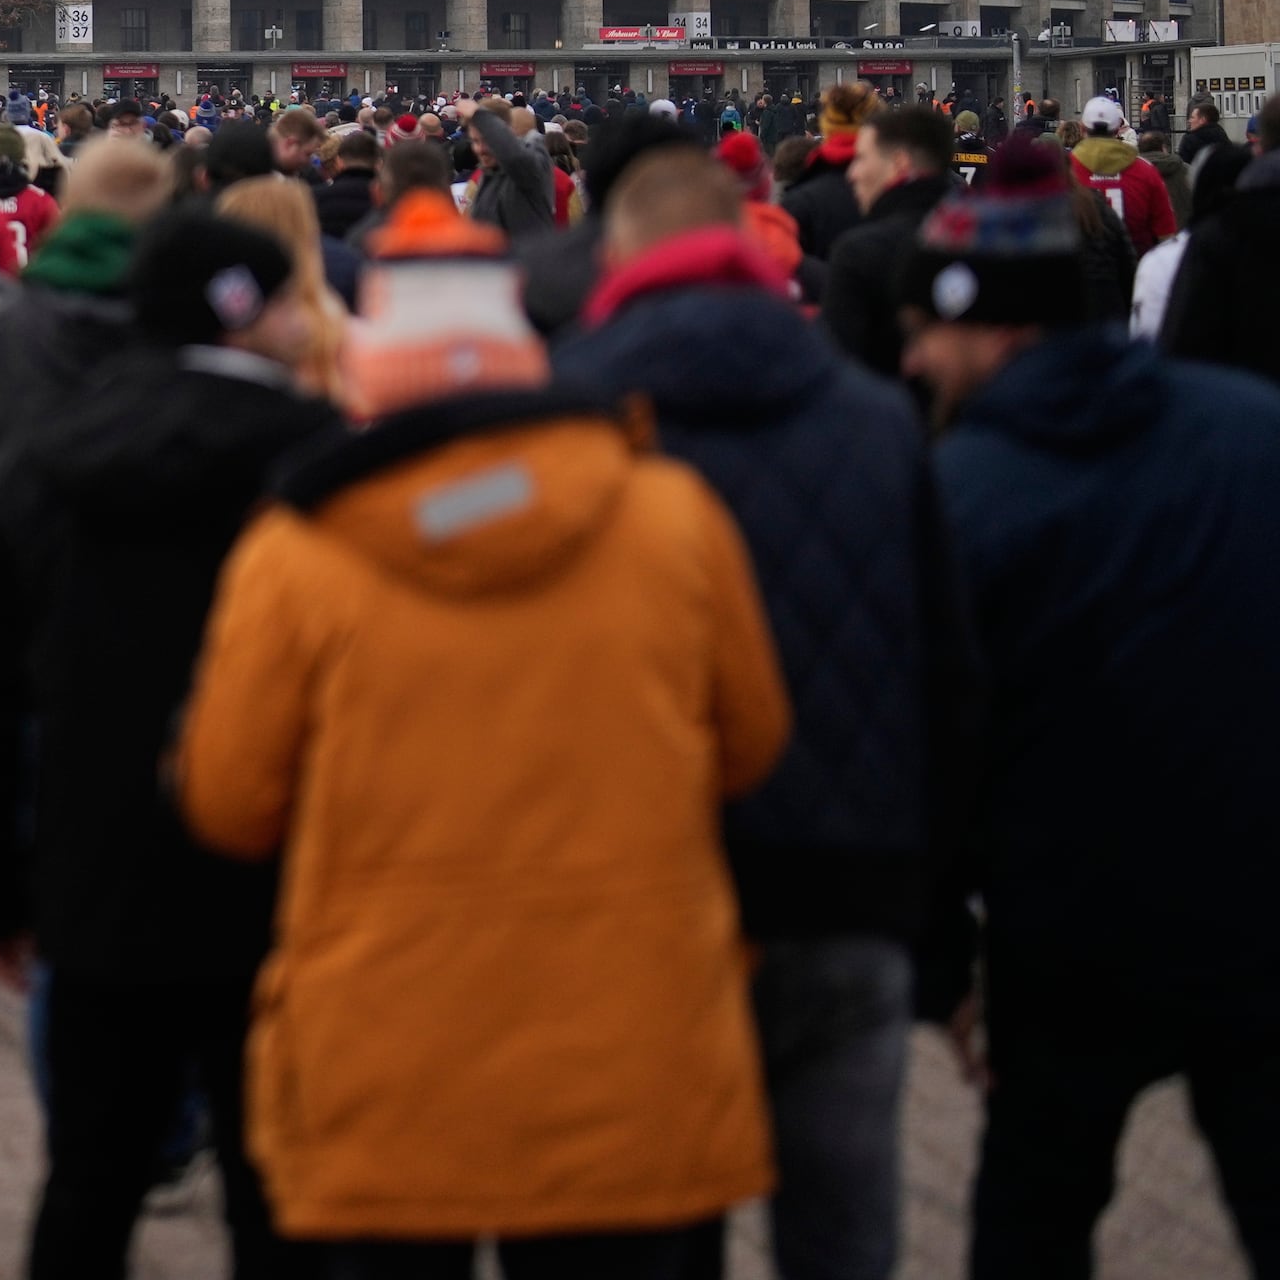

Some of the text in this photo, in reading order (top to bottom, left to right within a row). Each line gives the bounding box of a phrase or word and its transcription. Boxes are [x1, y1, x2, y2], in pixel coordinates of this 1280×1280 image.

[72, 10, 89, 22] 36
[695, 17, 708, 28] 34
[58, 26, 66, 39] 37
[72, 26, 89, 38] 37
[953, 25, 963, 38] Q
[959, 166, 977, 187] 7
